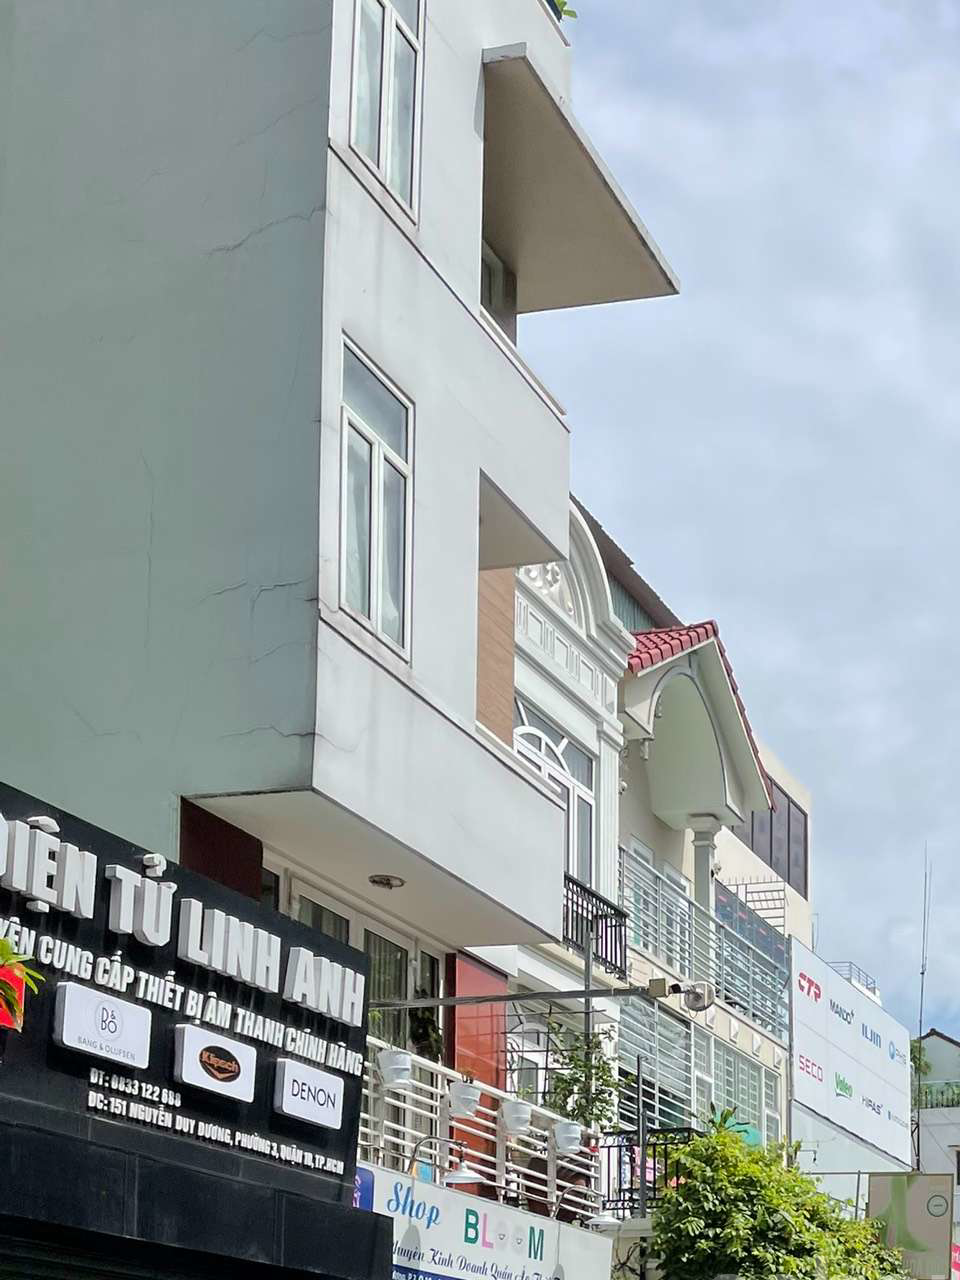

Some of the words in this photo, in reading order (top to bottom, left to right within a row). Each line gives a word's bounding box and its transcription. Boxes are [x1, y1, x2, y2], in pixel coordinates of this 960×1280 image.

[0, 813, 97, 919] IỆN
[105, 853, 178, 946] TỬ
[177, 898, 281, 993] LINH
[283, 947, 365, 1027] ANH
[39, 936, 94, 980] CUNG
[94, 950, 135, 992] CẤP
[135, 970, 184, 1011] THIẾT
[185, 989, 204, 1025] BỊ
[202, 991, 232, 1029] ÂM
[234, 1007, 285, 1048] THANH
[285, 1026, 328, 1063] CHÍNH
[798, 972, 821, 1004] CTR
[105, 1044, 136, 1061] OLUFSEN
[141, 1082, 160, 1101] 122
[291, 1079, 336, 1109] DENON
[109, 1097, 127, 1116] 151
[128, 1102, 173, 1128] NGUYỄN
[175, 1115, 196, 1134] DUY
[387, 1182, 440, 1229] Shop
[427, 1248, 453, 1268] Kinh
[456, 1254, 488, 1276] Doanh
